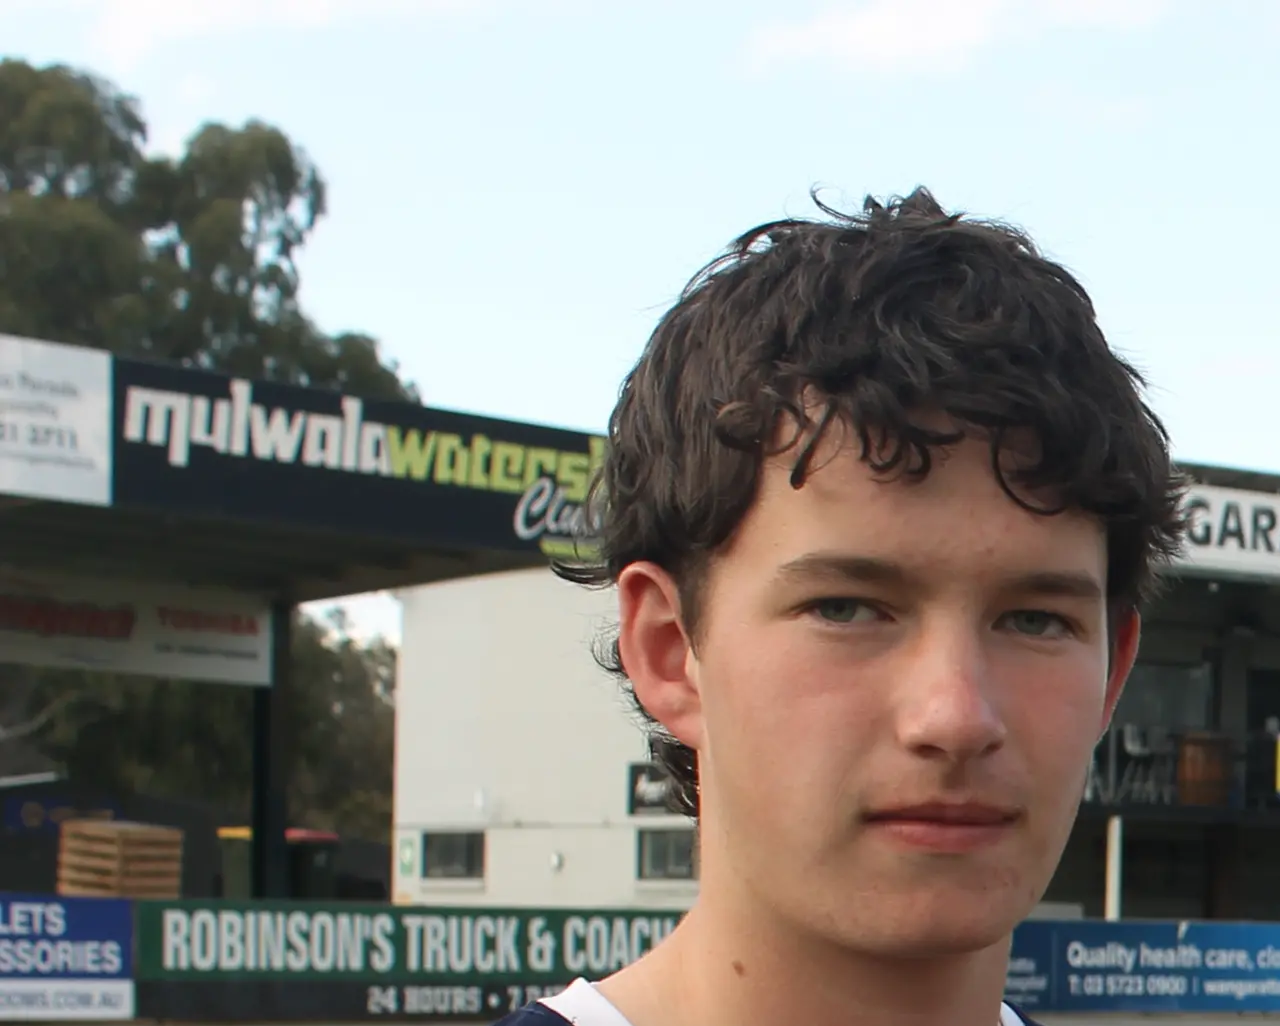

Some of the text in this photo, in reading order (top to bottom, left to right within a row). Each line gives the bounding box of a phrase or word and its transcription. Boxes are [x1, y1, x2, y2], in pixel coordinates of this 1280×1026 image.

[162, 908, 396, 973] ROBINSON'S
[402, 911, 521, 973] TRUCK
[526, 913, 556, 973] &
[1067, 940, 1137, 974] Quality
[1140, 942, 1201, 969] health
[1204, 948, 1254, 972] care,
